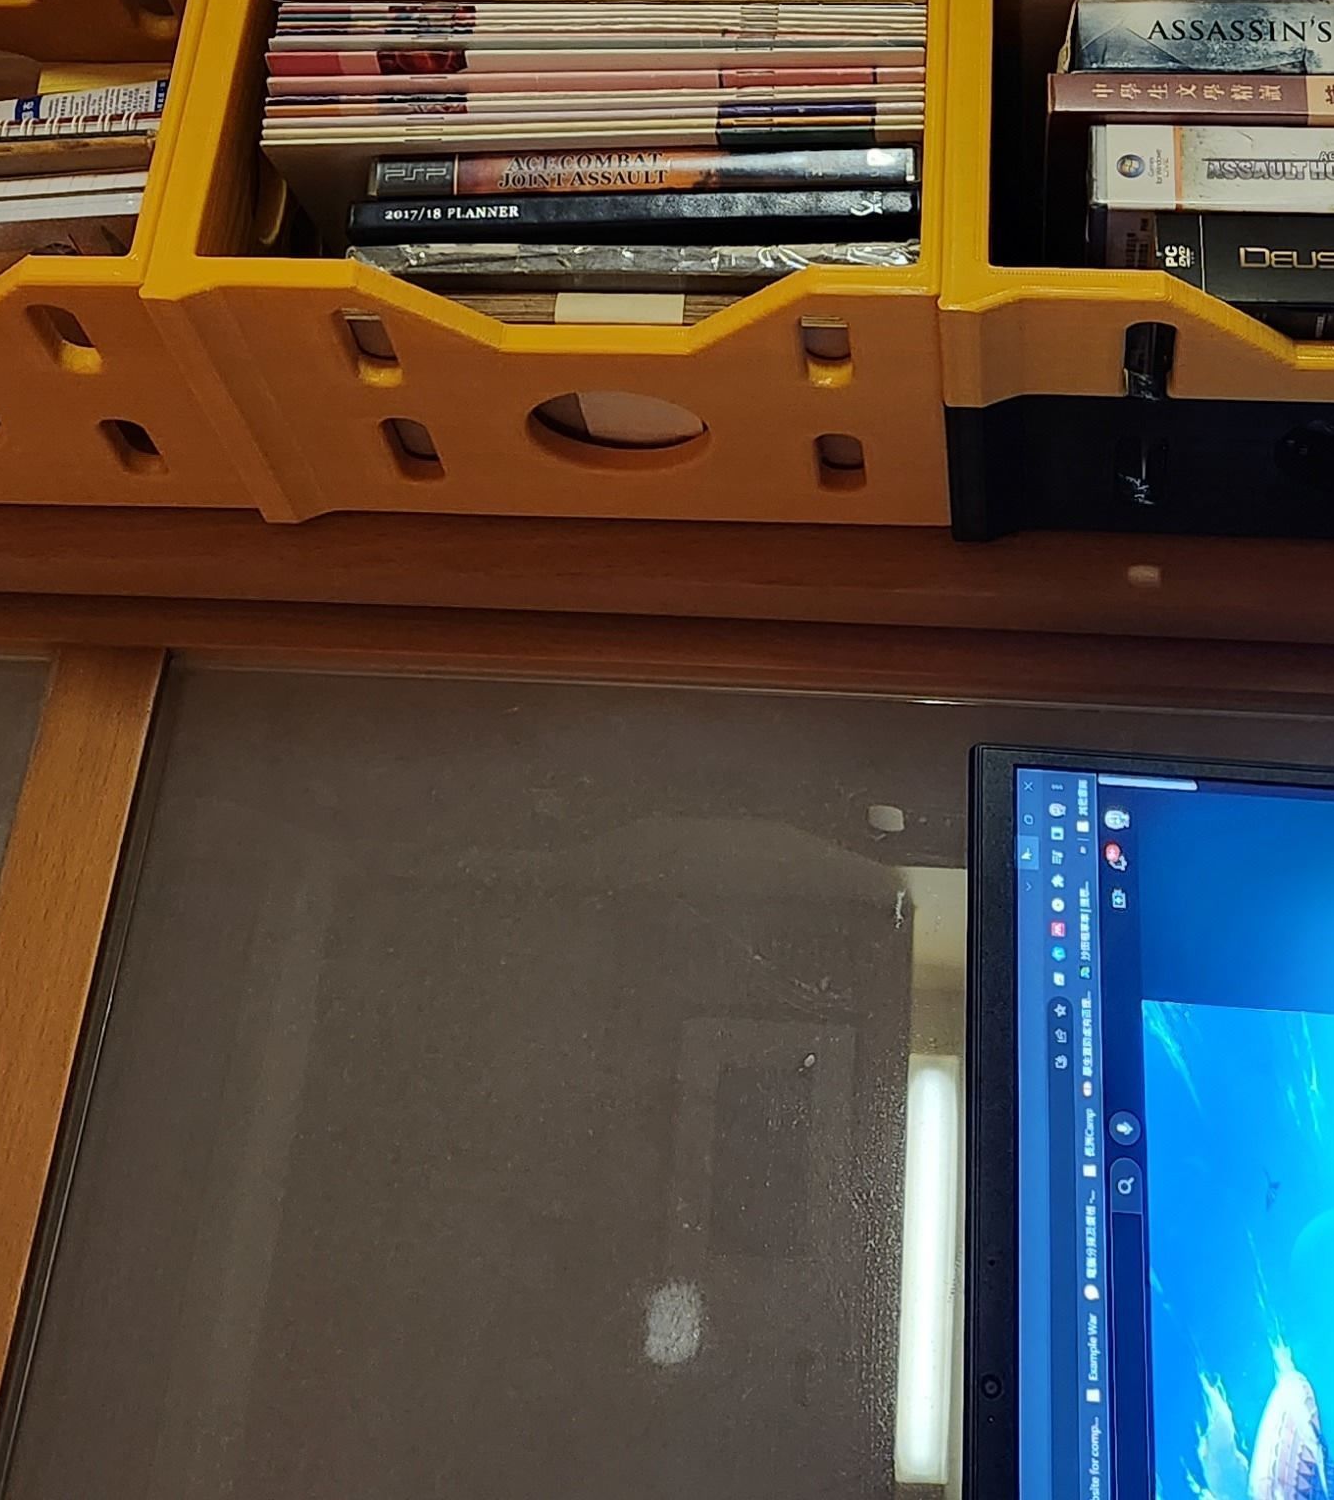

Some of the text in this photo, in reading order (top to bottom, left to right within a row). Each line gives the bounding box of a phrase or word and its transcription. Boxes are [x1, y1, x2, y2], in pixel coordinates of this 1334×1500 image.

[1148, 17, 1333, 45] ASSASSIN'S
[1091, 82, 1283, 101] 中學生文學精讀
[508, 152, 665, 171] ACE COMBAT
[1206, 161, 1305, 180] ASSAULT
[384, 166, 451, 183] PSP
[498, 168, 668, 189] JOINT ASSAULT
[384, 204, 520, 221] 2017/18 PLANNER
[1165, 245, 1178, 268] PC
[1086, 1313, 1100, 1381] Example War
